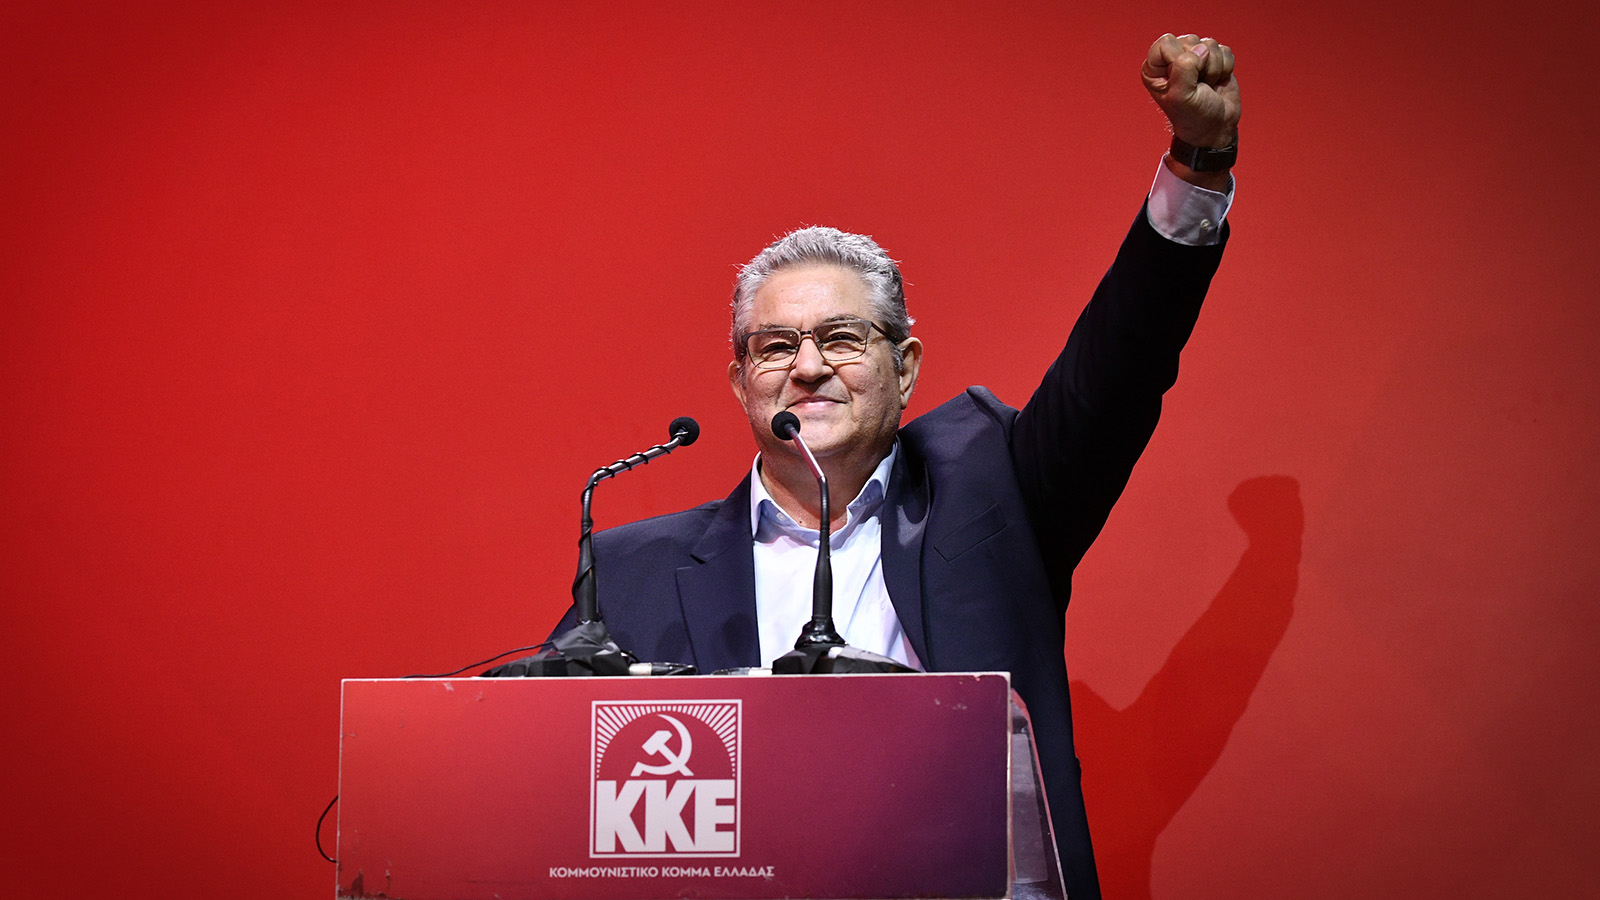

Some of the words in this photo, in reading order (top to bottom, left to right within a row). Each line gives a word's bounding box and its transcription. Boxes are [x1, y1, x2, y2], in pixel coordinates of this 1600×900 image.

[595, 779, 736, 853] ΚΚΕ
[549, 866, 659, 878] ΚΟΜΜΟΥΝΙΣΤΙΚΟ
[661, 866, 711, 877] ΚΟΜΜΑ
[713, 865, 775, 877] ΕΛΛΑΔΑΣ
